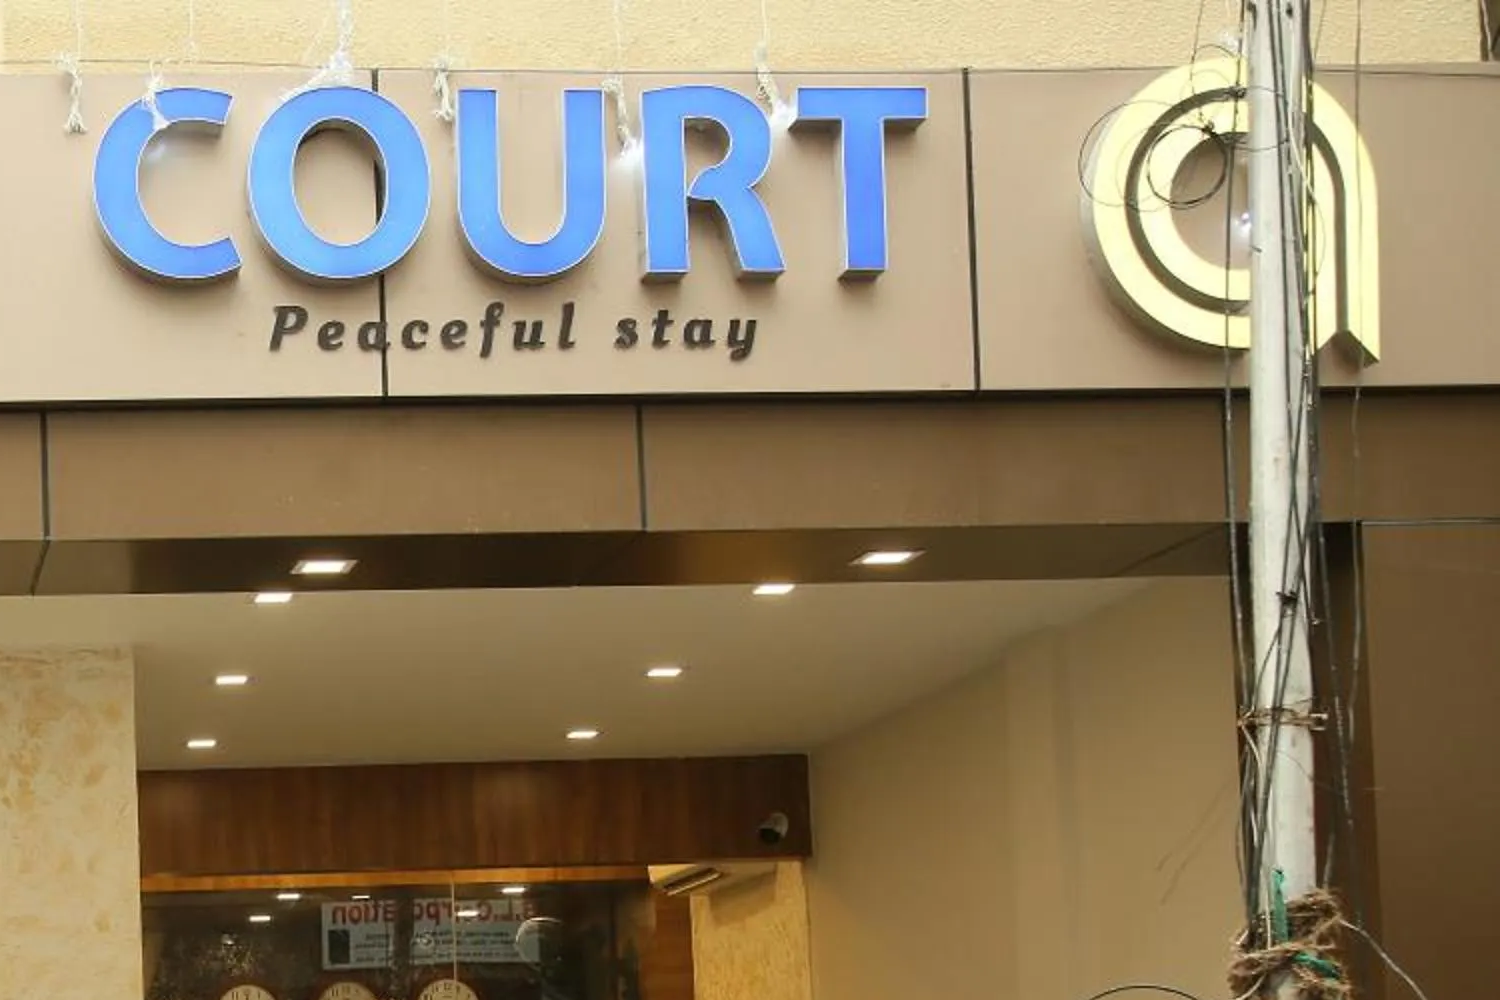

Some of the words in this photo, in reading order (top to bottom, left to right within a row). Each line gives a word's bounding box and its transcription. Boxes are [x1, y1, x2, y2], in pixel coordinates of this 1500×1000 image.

[92, 84, 929, 284] COURT
[269, 301, 576, 358] Peaceful
[613, 307, 759, 362] stay
